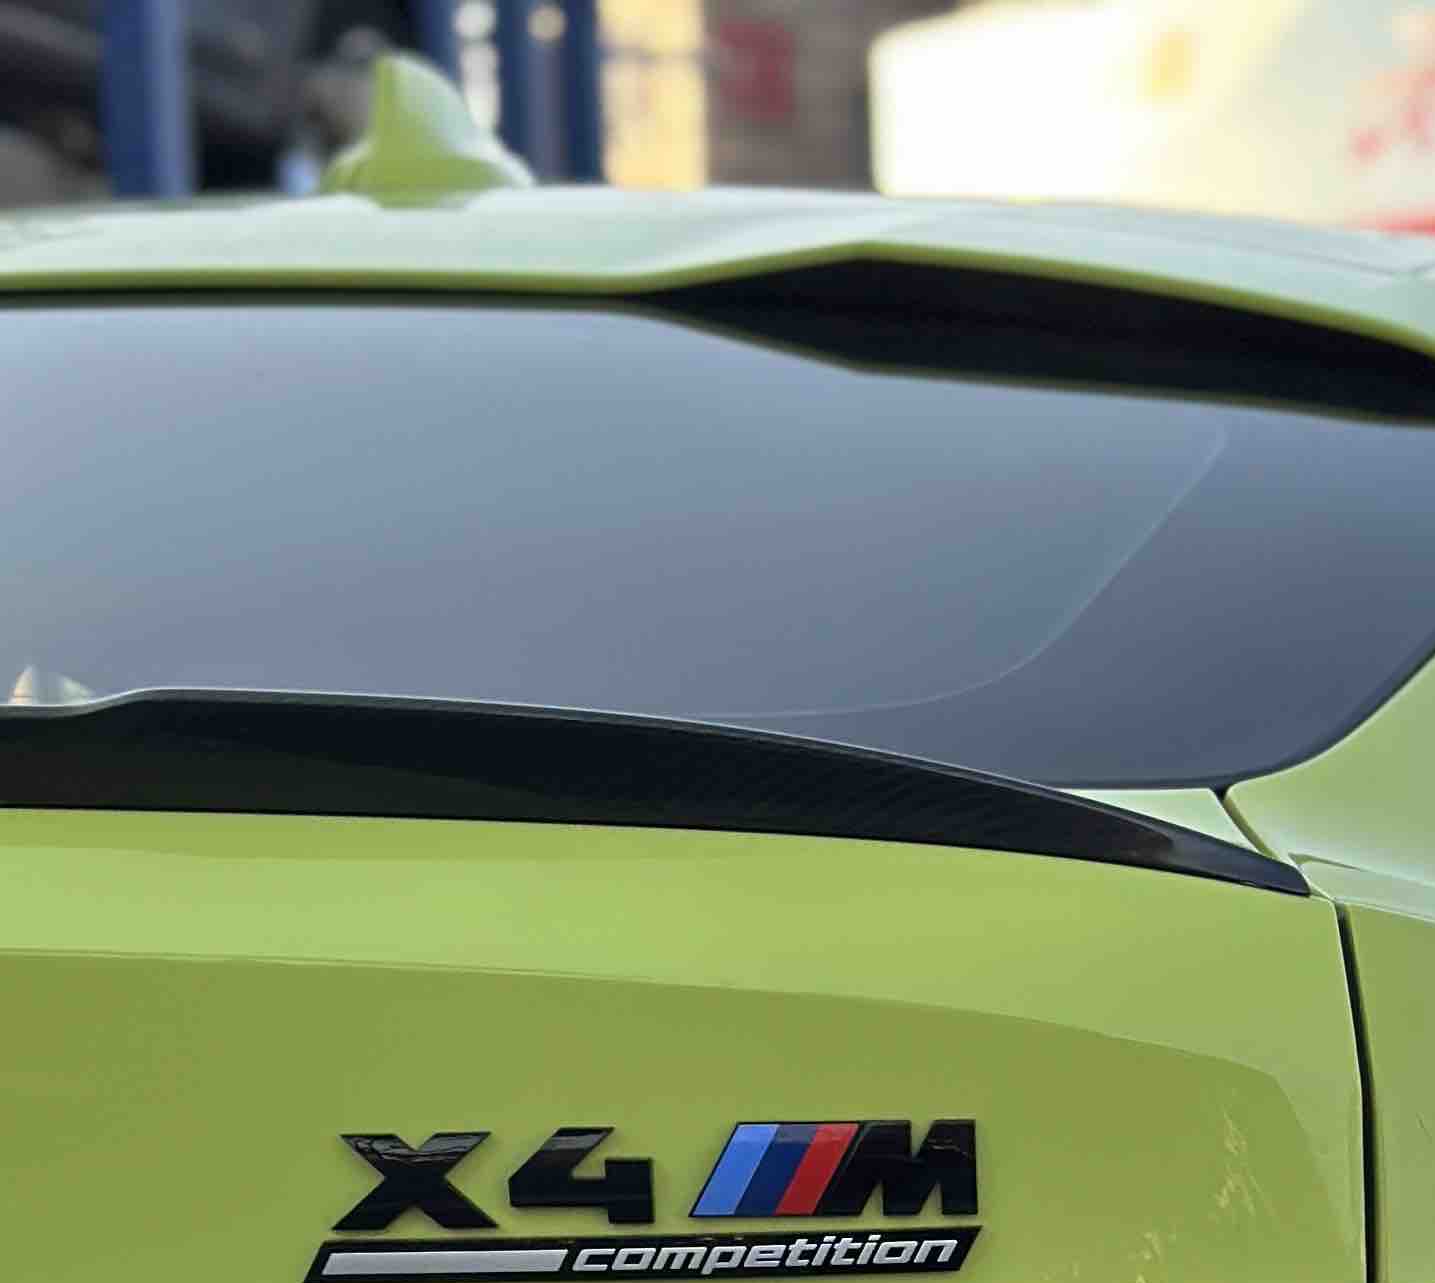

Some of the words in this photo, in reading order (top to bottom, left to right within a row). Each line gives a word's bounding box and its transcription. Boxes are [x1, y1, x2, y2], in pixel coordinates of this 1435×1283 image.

[331, 1127, 656, 1231] X4
[812, 1119, 979, 1218] M
[571, 1234, 960, 1276] competition
